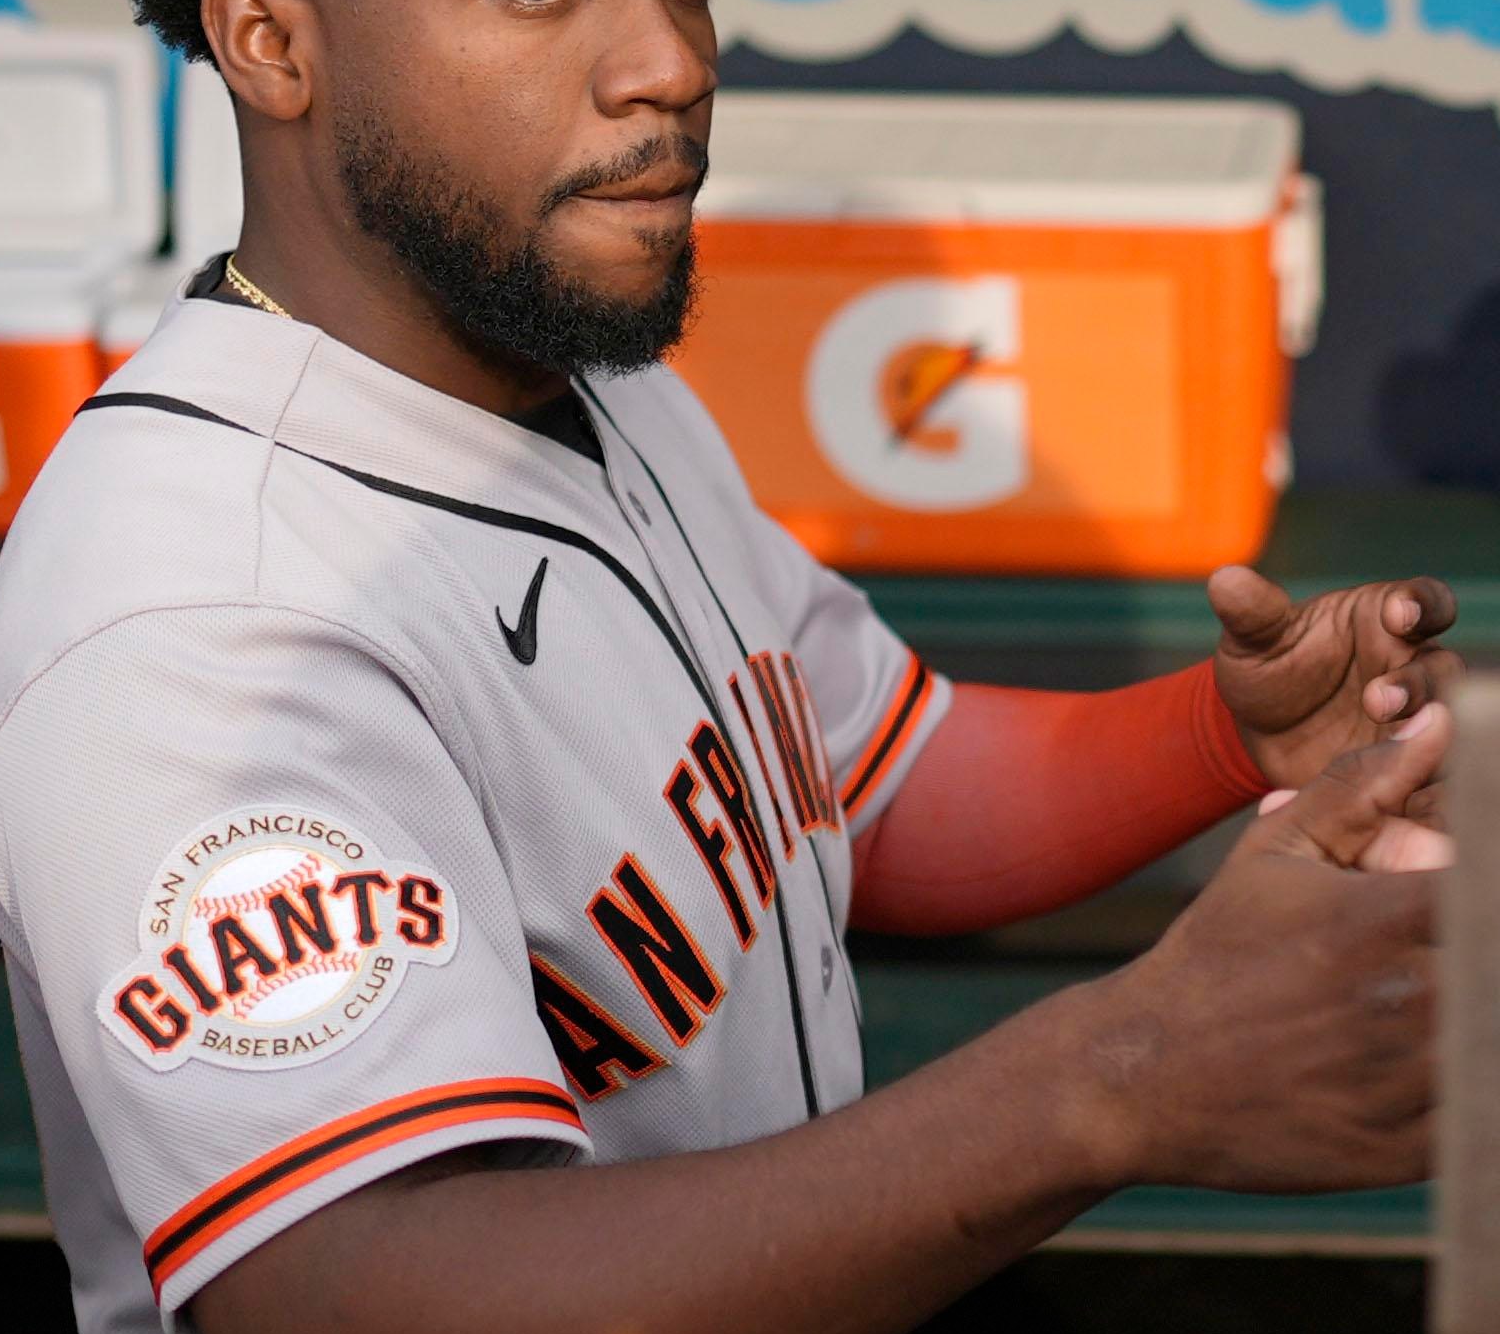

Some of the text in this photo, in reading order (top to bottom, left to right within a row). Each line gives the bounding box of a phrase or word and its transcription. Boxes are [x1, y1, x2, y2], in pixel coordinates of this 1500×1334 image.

[805, 273, 1033, 514] G
[112, 869, 446, 1056] GIANTS
[149, 814, 366, 937] SAN FRANCISCO
[200, 954, 396, 1058] BASEBALL CLUB
[528, 852, 727, 1103] AN
